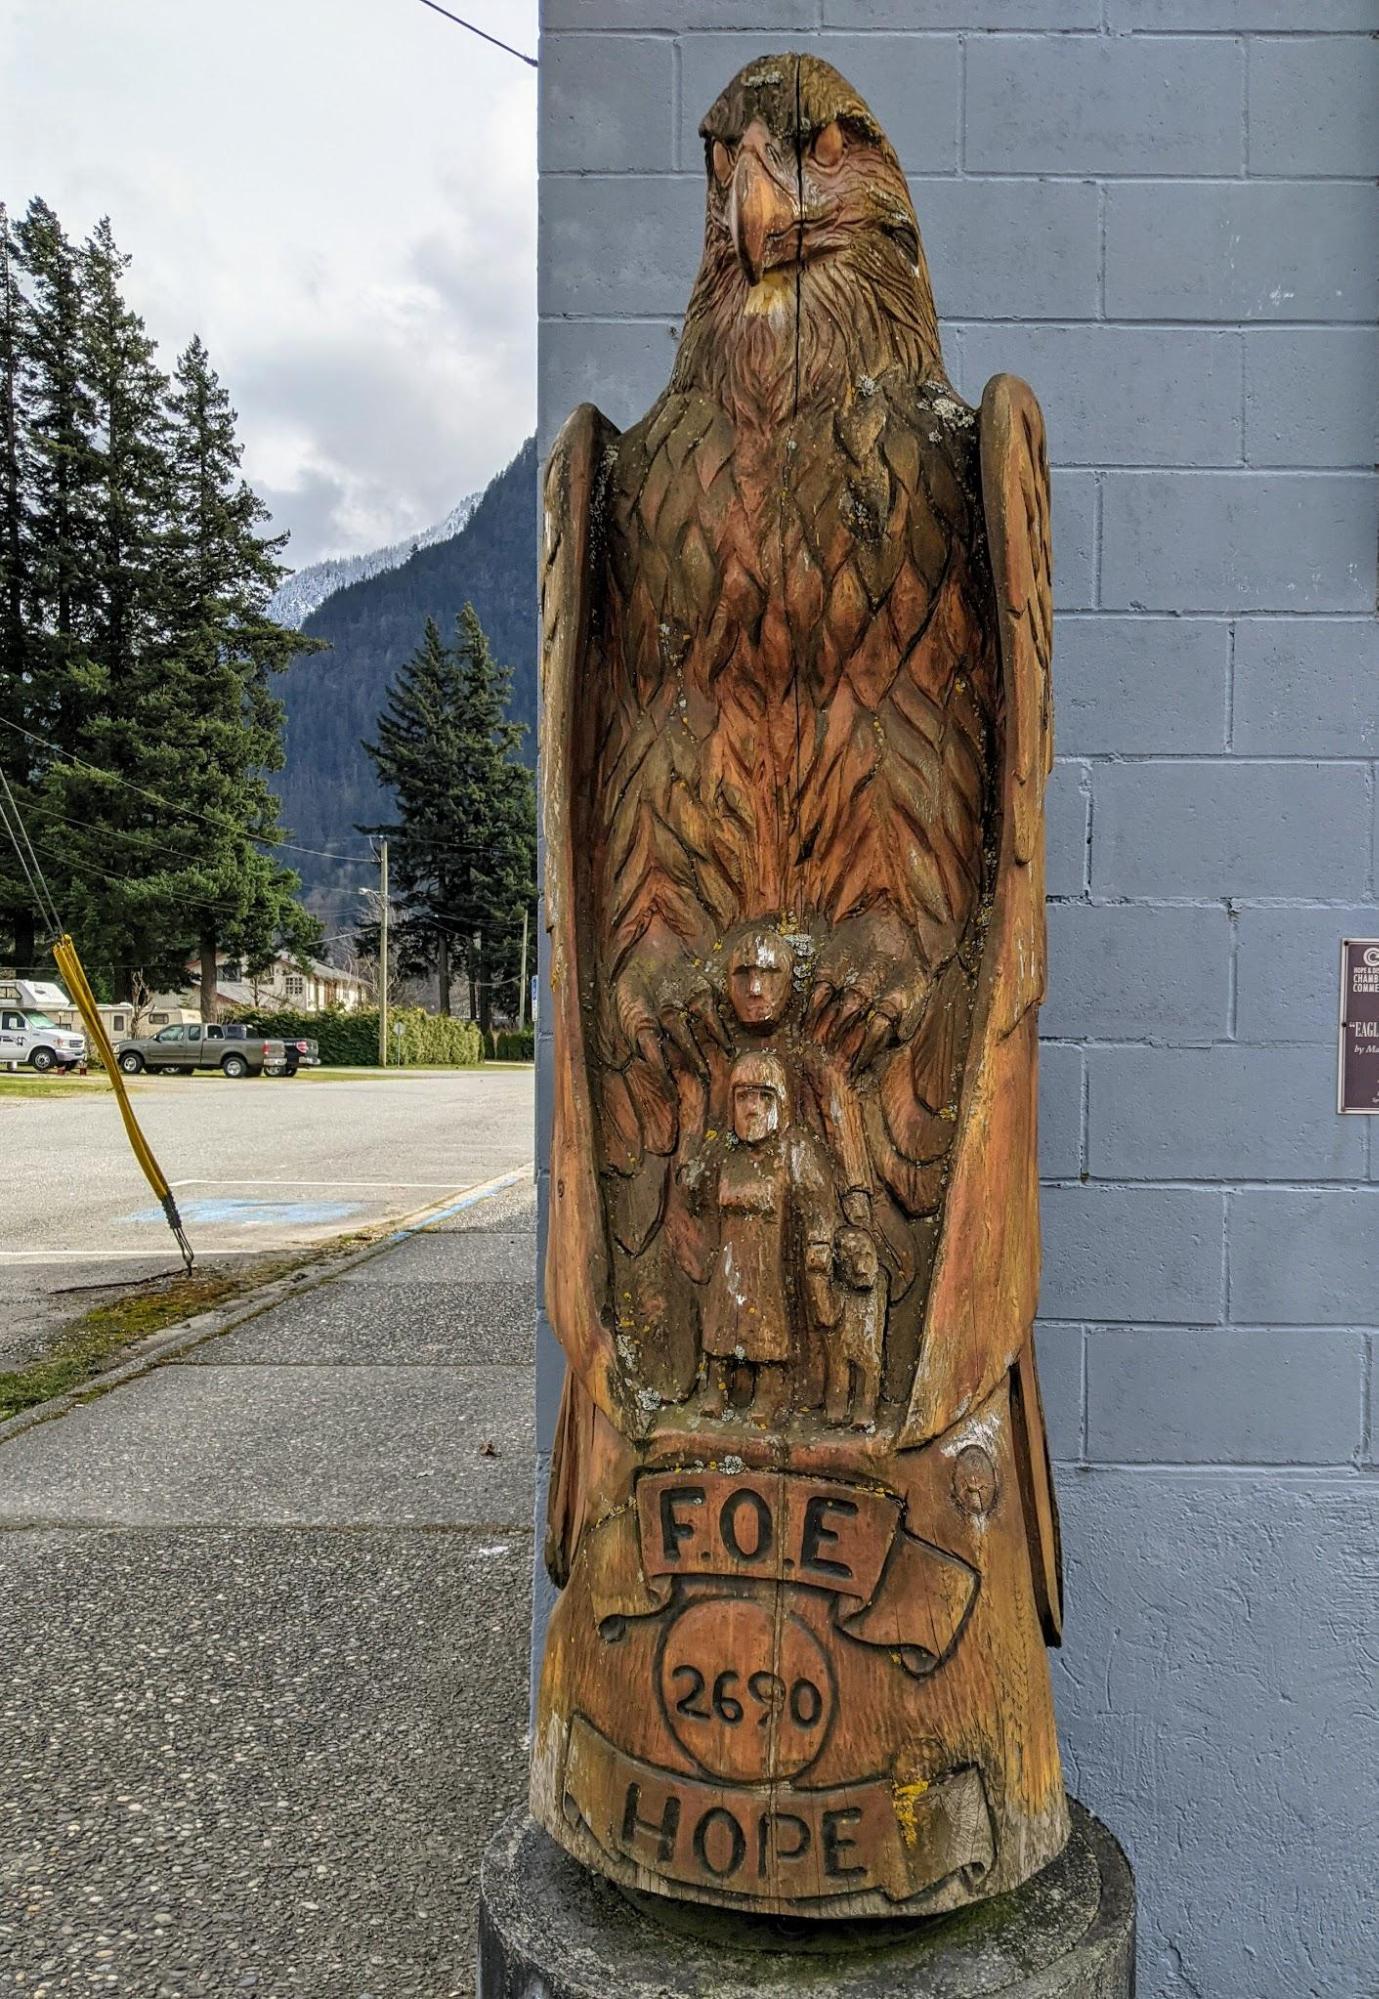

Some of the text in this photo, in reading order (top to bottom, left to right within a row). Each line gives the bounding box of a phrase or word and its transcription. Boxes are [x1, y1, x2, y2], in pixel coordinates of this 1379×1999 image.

[1354, 1044, 1365, 1055] by
[672, 1663, 823, 1730] 2690
[622, 1782, 868, 1881] HOPE
